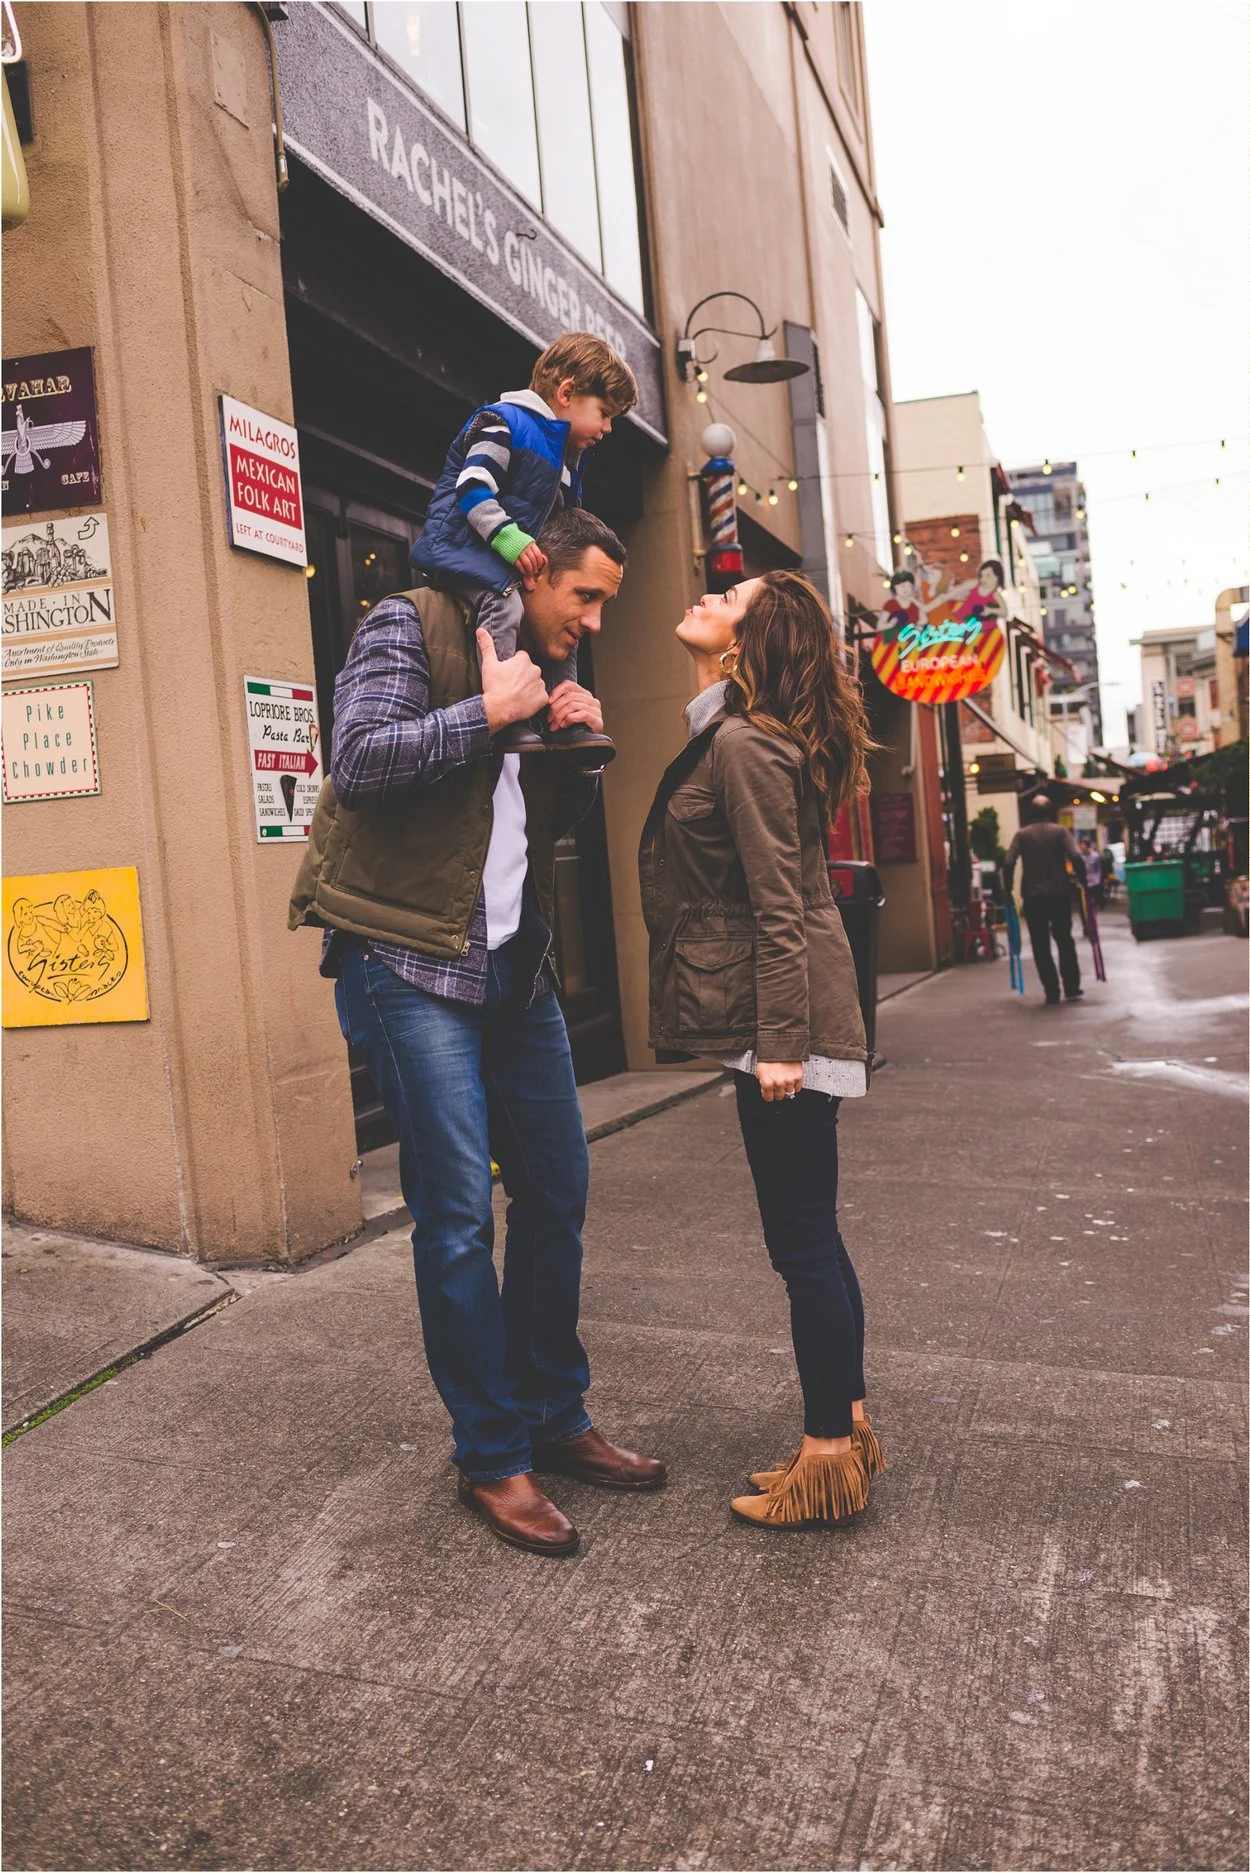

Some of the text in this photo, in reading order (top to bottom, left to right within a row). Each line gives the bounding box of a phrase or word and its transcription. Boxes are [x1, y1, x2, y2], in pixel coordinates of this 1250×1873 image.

[367, 98, 500, 265] RACHEL'S
[504, 230, 581, 332] GINGER
[230, 414, 296, 460] MILAGROS
[61, 471, 90, 486] CAFE
[236, 454, 296, 495] MEXICAN
[237, 482, 296, 521] FOLK ART
[236, 523, 304, 553] LEFT AT COURTYARD
[2, 589, 112, 634] SHINGTON
[4, 591, 81, 615] MADE IN
[85, 638, 115, 649] Products
[34, 651, 79, 664] Washington
[901, 655, 978, 673] EUROPEAN
[26, 703, 64, 722] Pike
[249, 701, 316, 724] LOPRIORE BROS.
[23, 732, 72, 750] Place
[262, 724, 310, 743] Pasta Bar
[12, 756, 87, 779] Chowder
[257, 752, 306, 770] FAST ITALIAN
